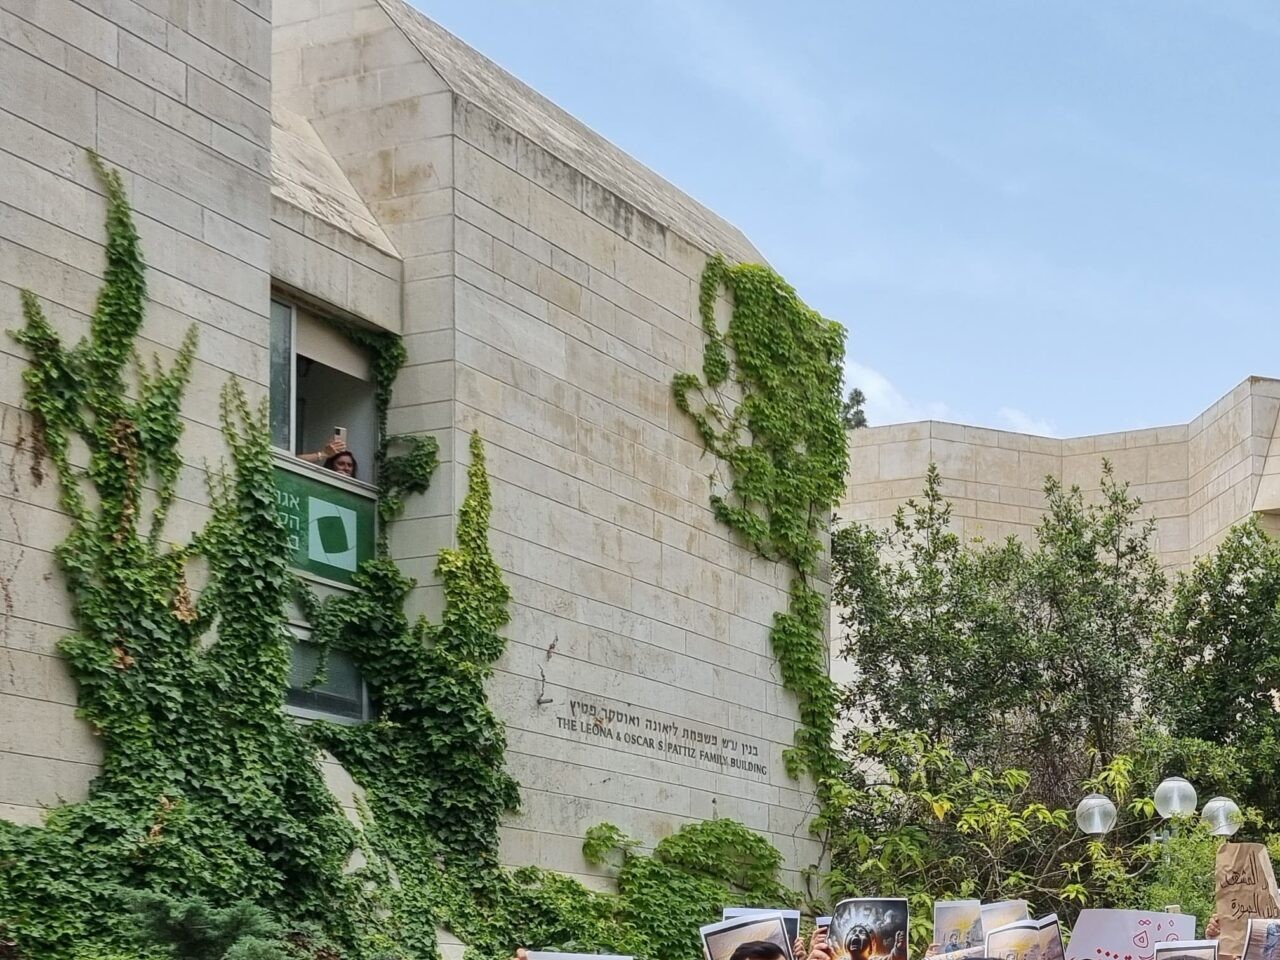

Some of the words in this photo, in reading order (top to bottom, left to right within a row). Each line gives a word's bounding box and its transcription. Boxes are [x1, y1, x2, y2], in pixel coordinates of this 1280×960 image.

[570, 700, 597, 716] פטיץ
[645, 719, 679, 736] ליאונה
[556, 716, 578, 731] THE
[580, 721, 613, 739] LEONA
[616, 732, 622, 742] &
[624, 733, 655, 749] OSCAR
[668, 742, 697, 759] PATTIZ
[700, 750, 728, 765] FAMILY
[731, 758, 767, 775] BUILDING
[682, 728, 718, 746] משפחת
